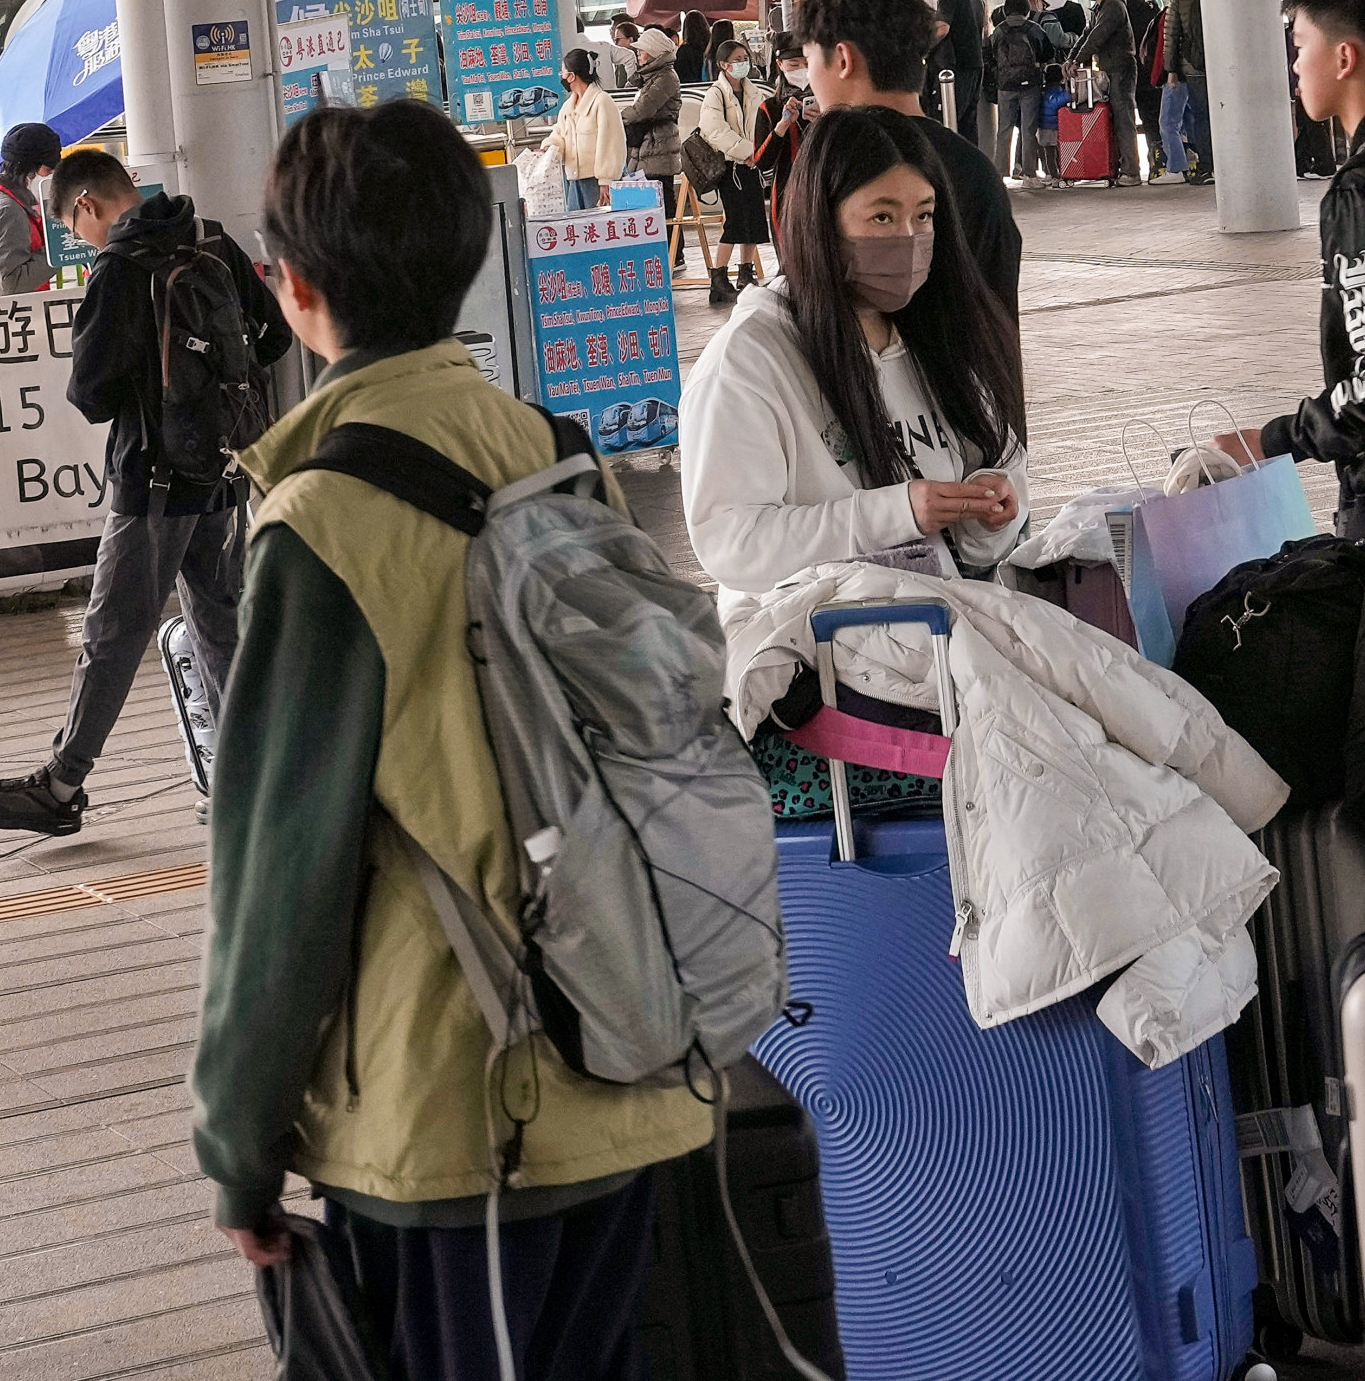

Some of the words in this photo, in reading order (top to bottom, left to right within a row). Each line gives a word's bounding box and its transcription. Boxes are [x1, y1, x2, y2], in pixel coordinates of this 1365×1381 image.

[363, 26, 381, 38] Sha
[384, 24, 405, 35] Tsui
[351, 72, 385, 83] Prince
[388, 64, 429, 78] Edward
[564, 216, 659, 247] 粵港直通巴
[58, 251, 86, 262] Tsuen
[17, 457, 108, 508] Bay
